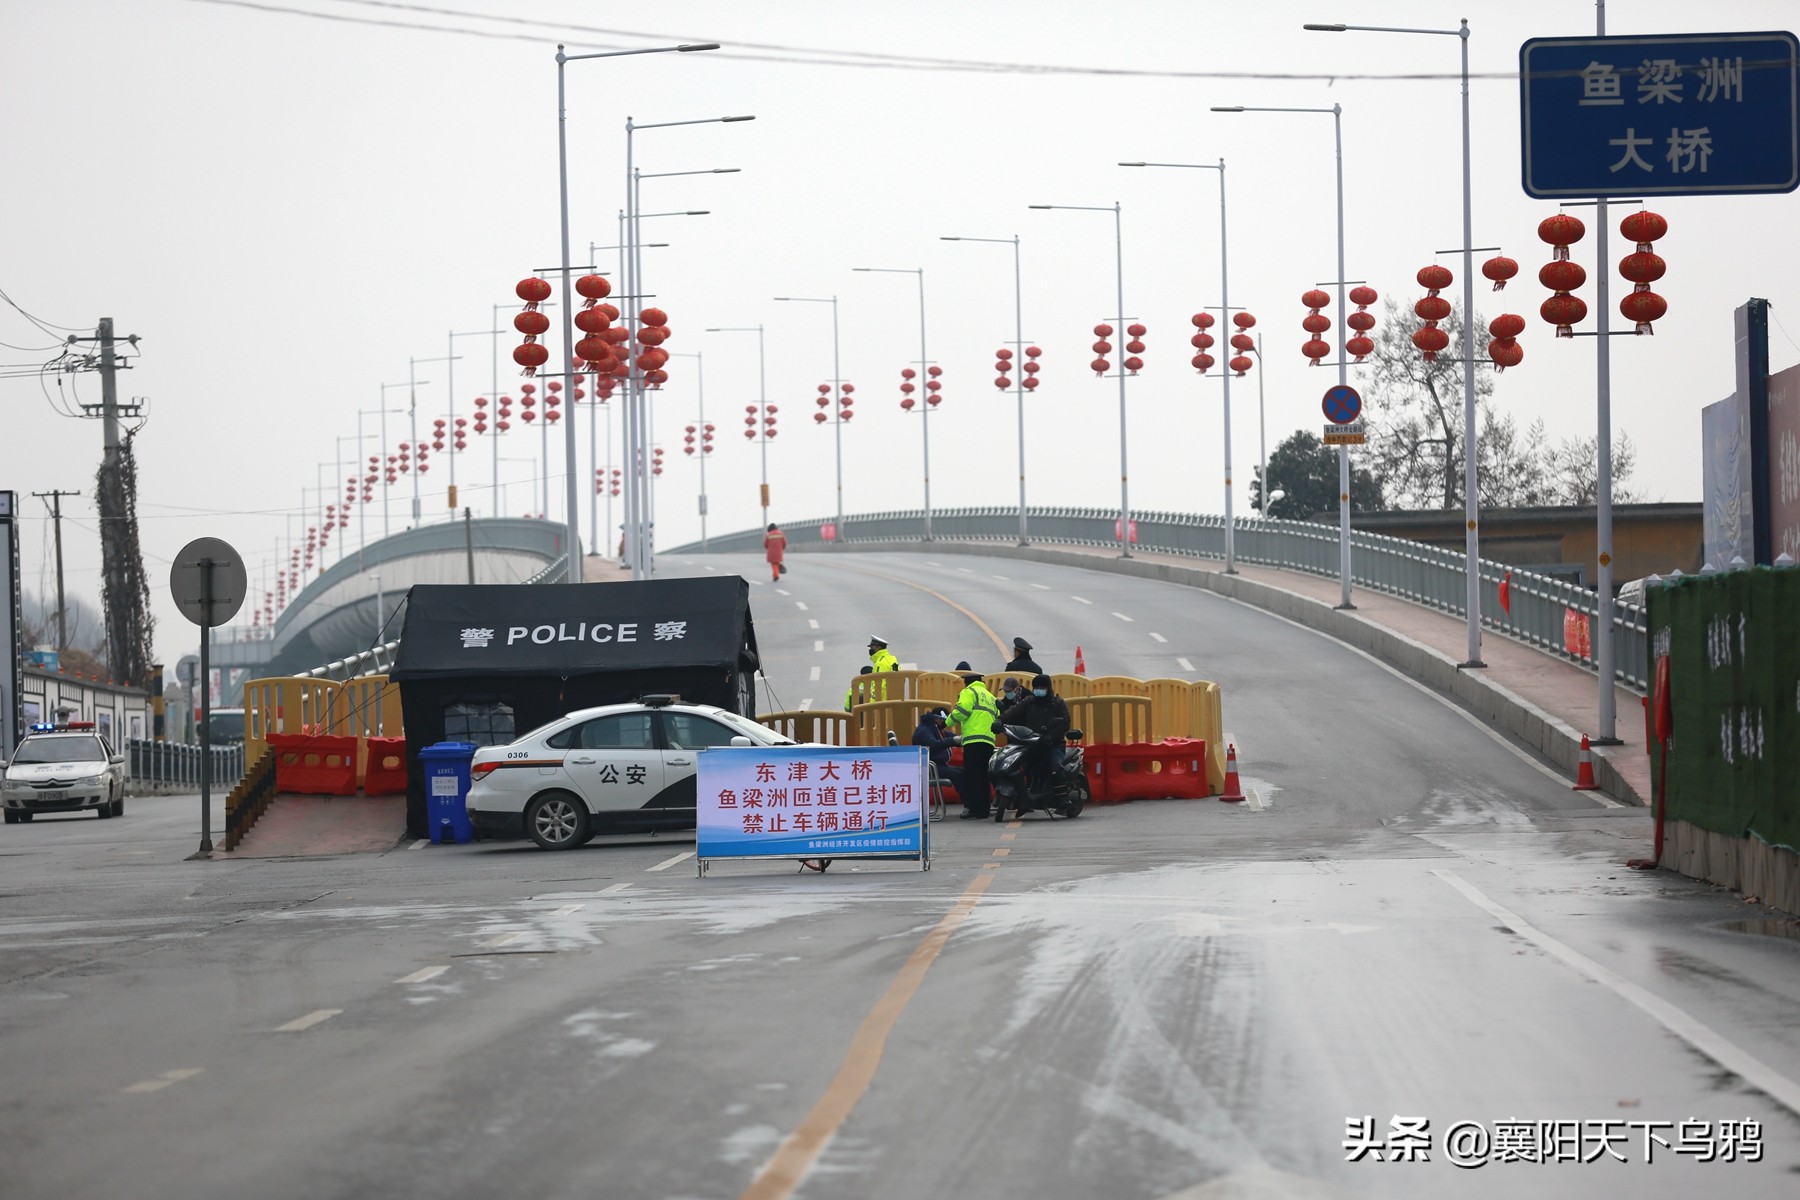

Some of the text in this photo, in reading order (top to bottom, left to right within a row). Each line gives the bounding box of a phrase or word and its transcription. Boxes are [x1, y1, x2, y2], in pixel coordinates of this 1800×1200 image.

[1578, 56, 1744, 107] 鱼梁洲
[1609, 126, 1714, 174] 大桥
[460, 621, 688, 648] 警 POLICE 察
[507, 751, 529, 760] 0306
[599, 764, 647, 785] 公安
[755, 759, 873, 783] 东津大桥
[718, 784, 913, 809] 鱼梁洲匝道已封闭
[742, 810, 890, 834] 禁止车辆通行
[808, 838, 912, 849] 鱼梁洲经济开发区疫情防控指挥部
